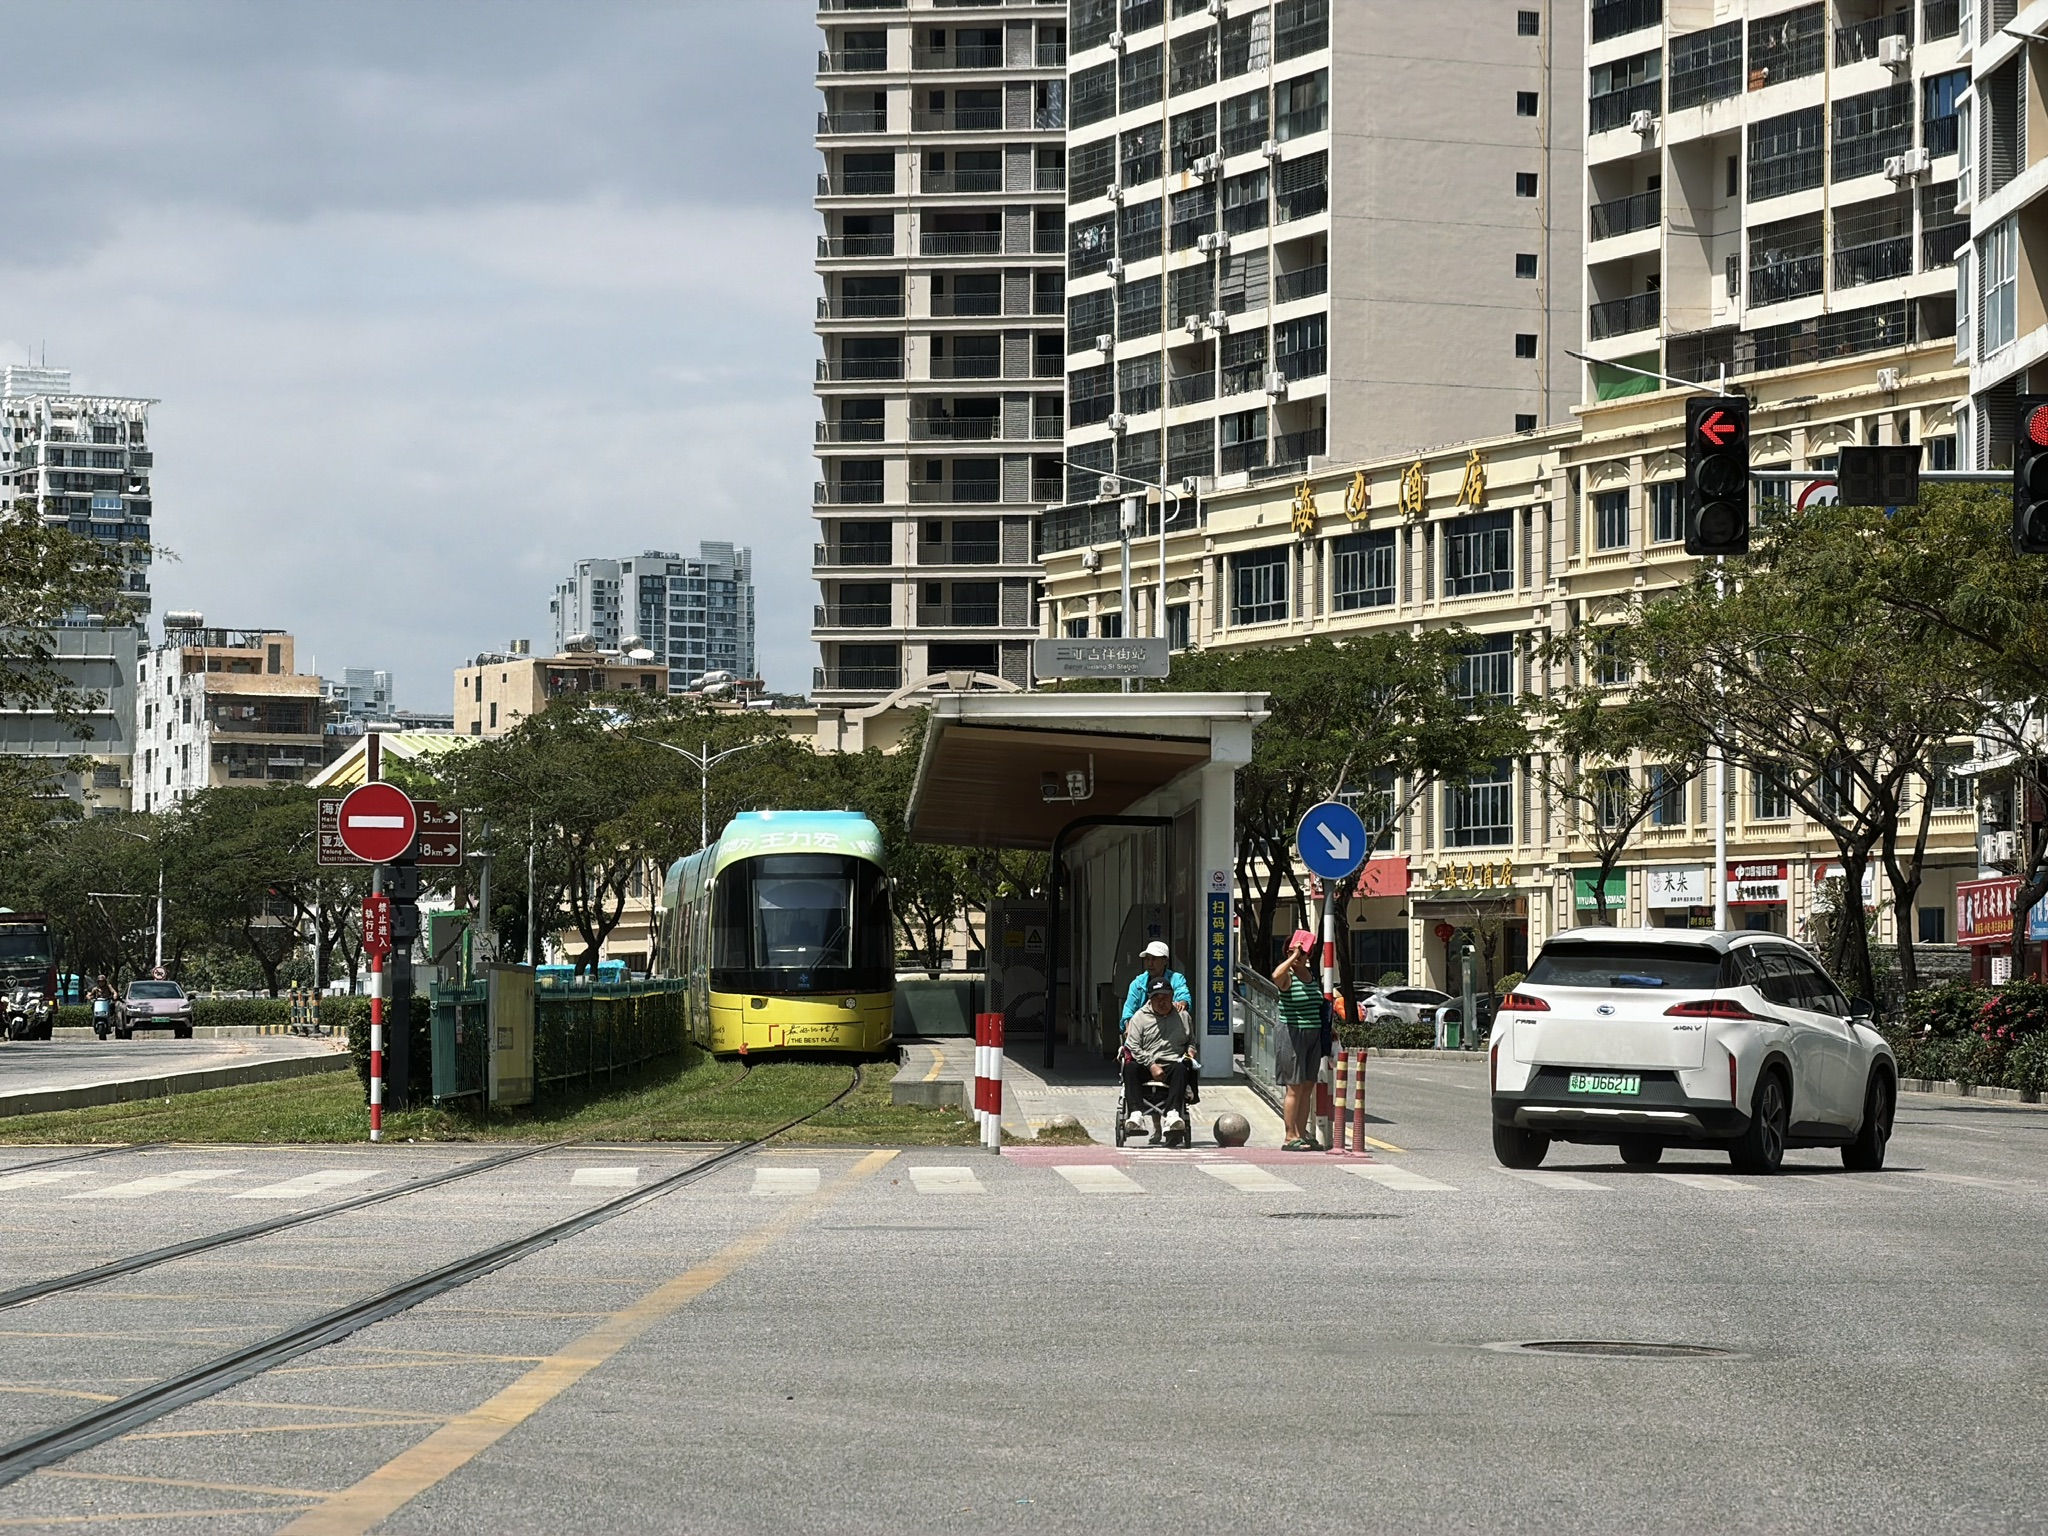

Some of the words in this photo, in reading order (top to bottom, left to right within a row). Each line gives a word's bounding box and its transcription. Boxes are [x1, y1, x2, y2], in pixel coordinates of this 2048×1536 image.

[1291, 449, 1483, 533] 海边酒店
[1057, 646, 1147, 661] 三亚吉祥街站
[423, 811, 431, 824] 5
[760, 832, 840, 849] 王力宏
[1444, 857, 1513, 889] 海边酒店
[1664, 871, 1688, 892] 米朵
[378, 902, 388, 947] 禁止进入
[1212, 900, 1225, 1021] 扫码乘车全程3元
